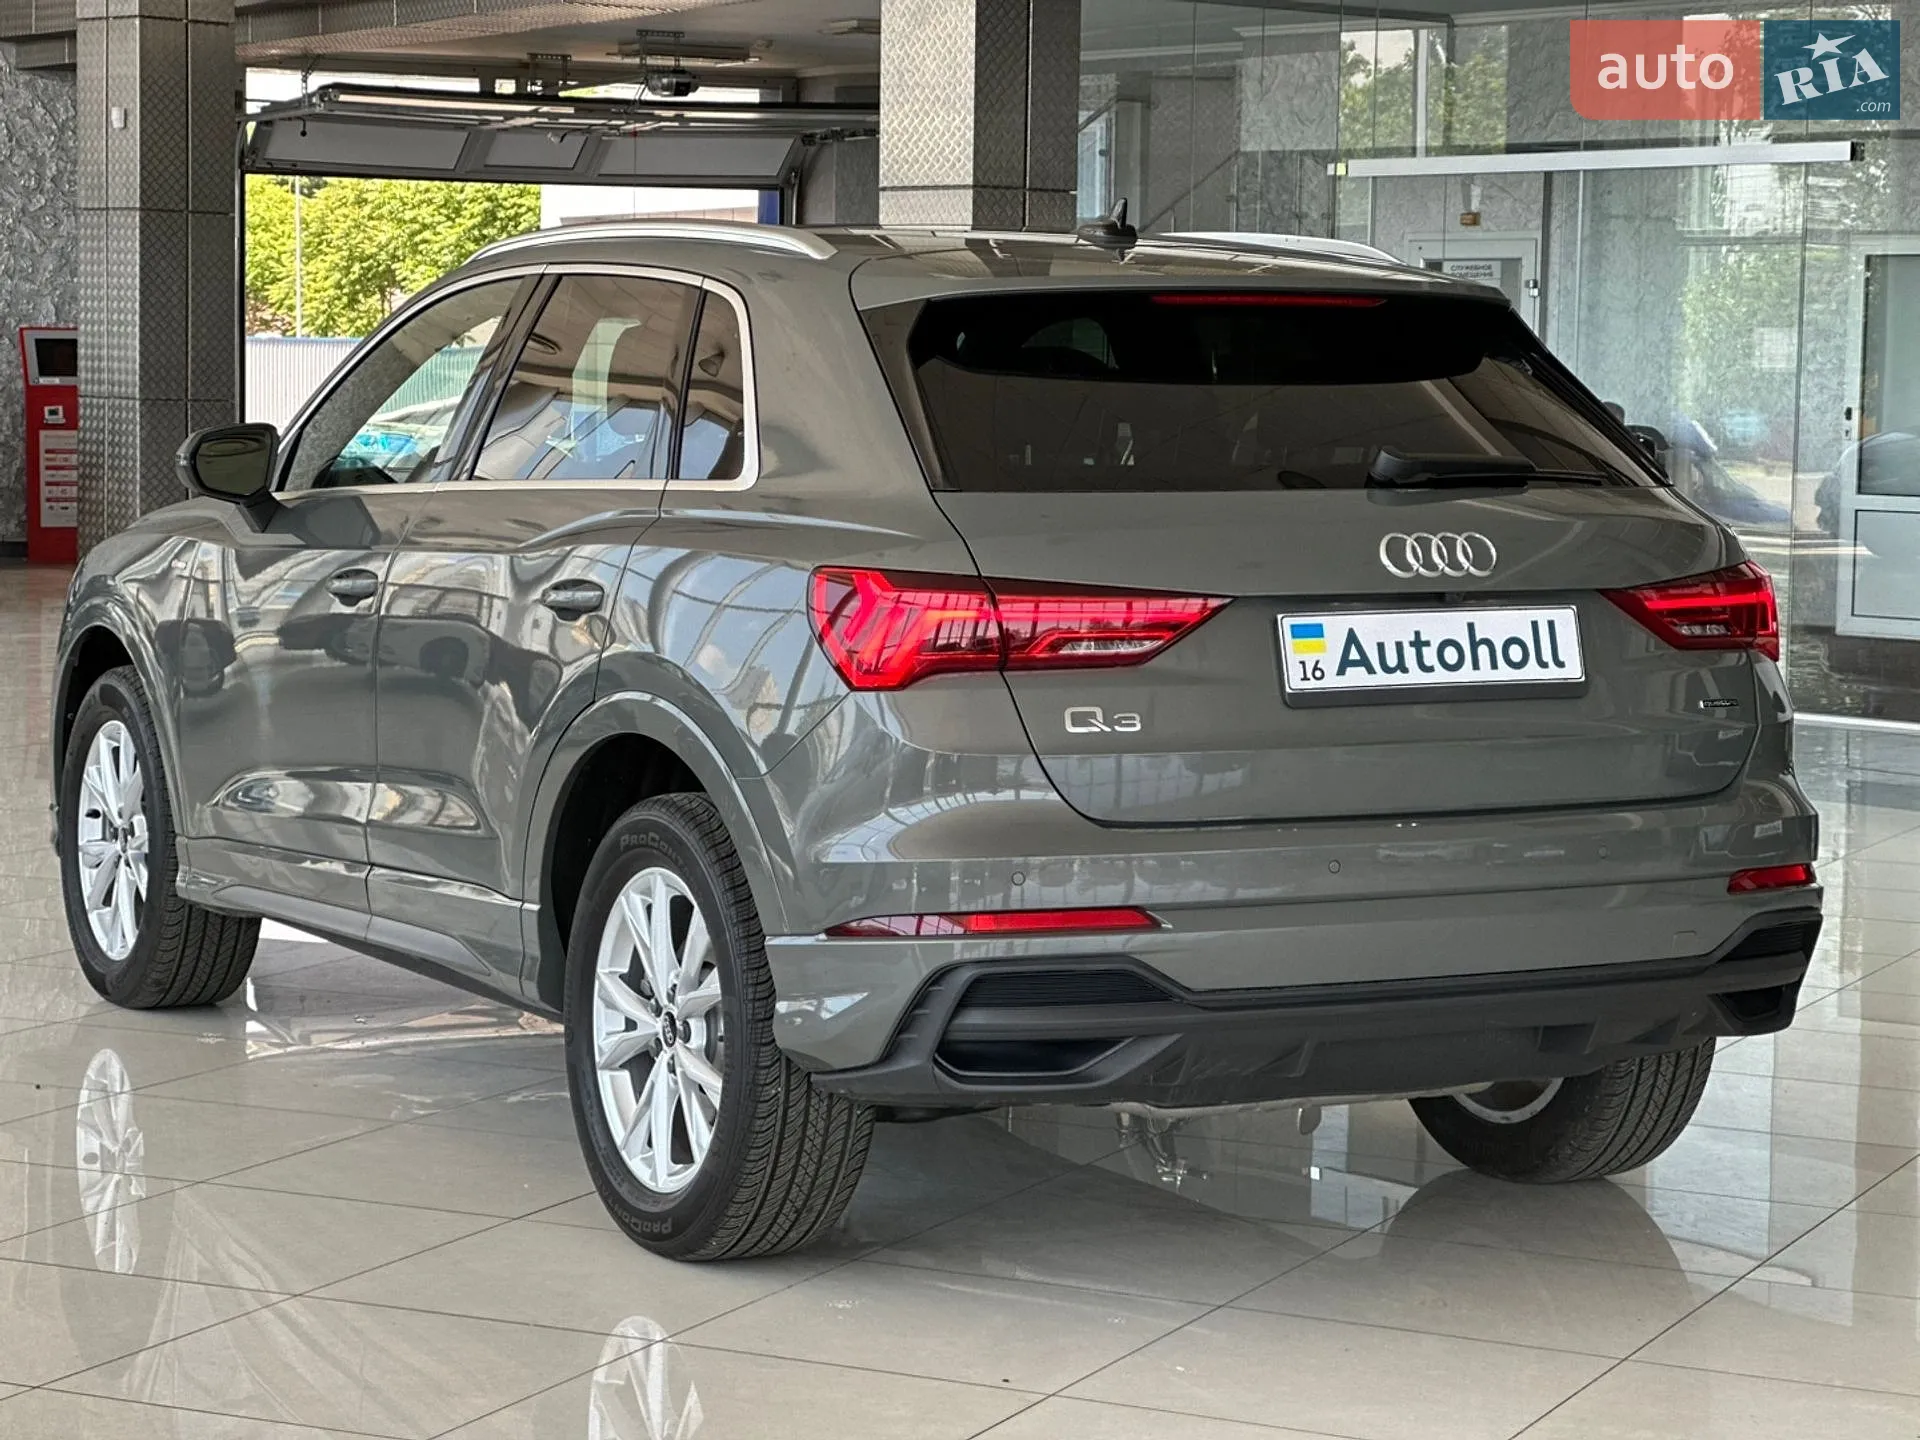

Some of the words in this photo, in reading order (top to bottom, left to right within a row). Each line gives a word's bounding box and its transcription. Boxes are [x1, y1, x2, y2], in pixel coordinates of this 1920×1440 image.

[1298, 659, 1326, 682] 16
[1335, 619, 1566, 677] Autoholl
[1064, 706, 1142, 733] Q3
